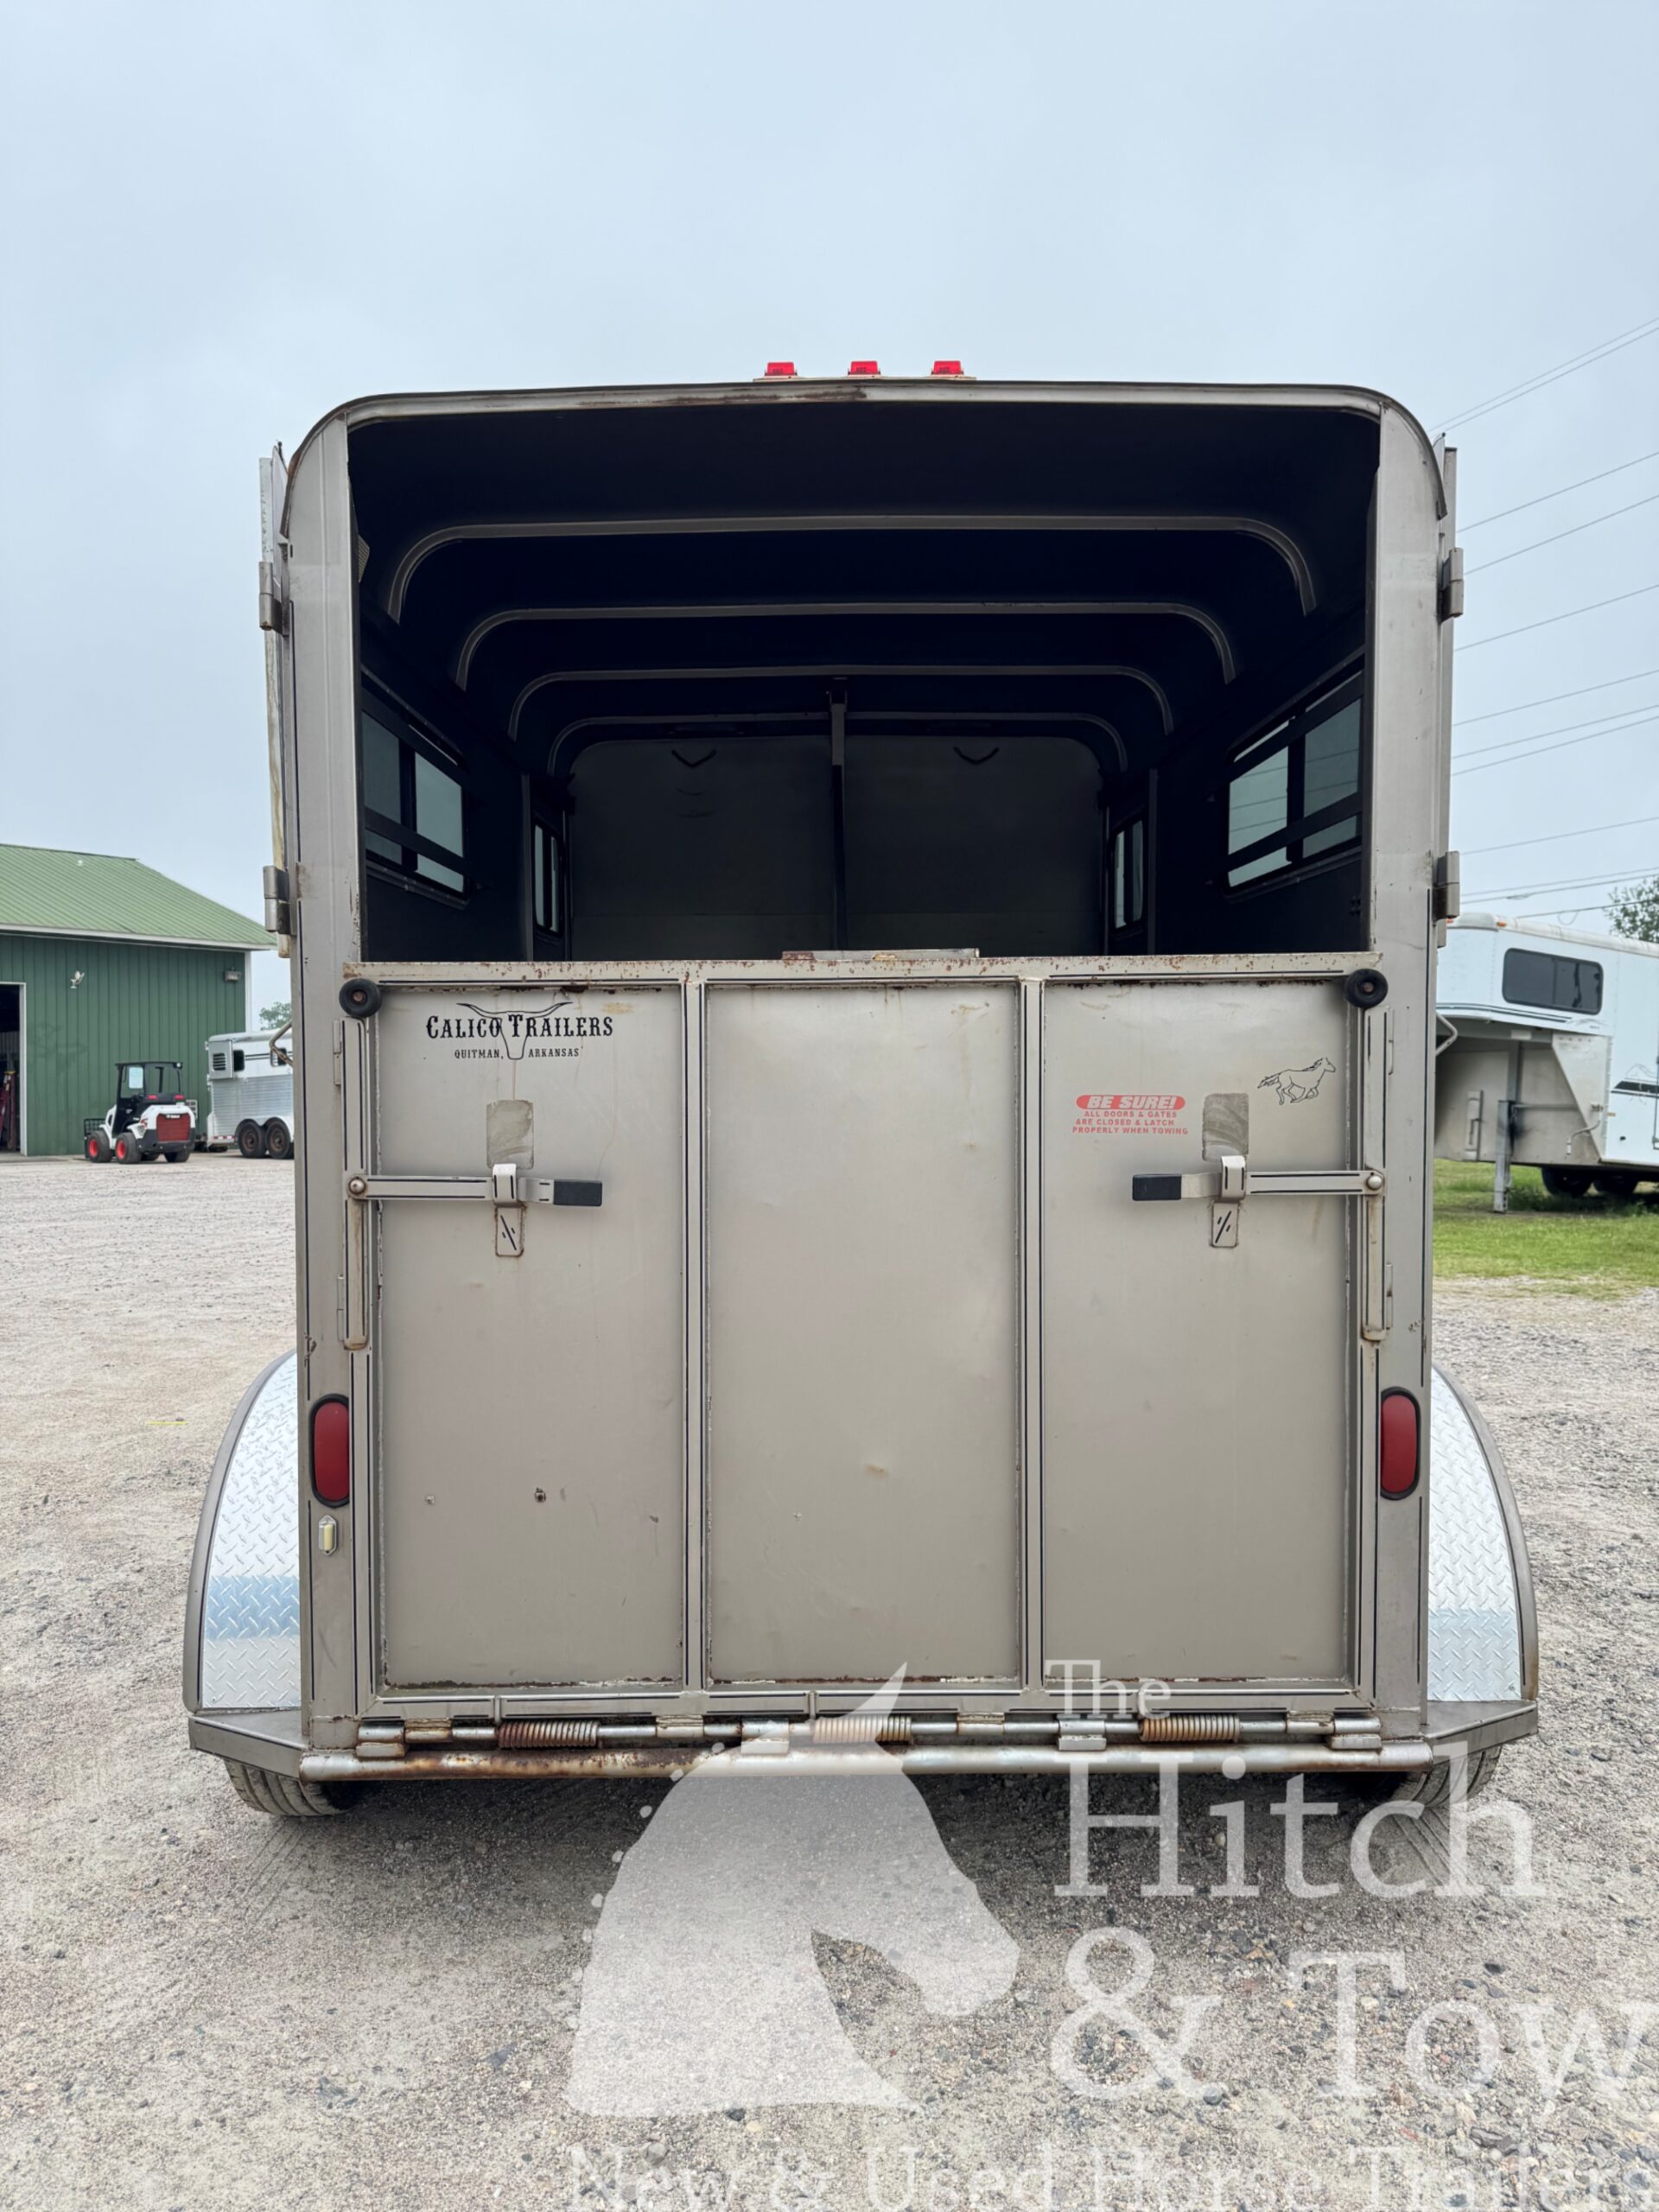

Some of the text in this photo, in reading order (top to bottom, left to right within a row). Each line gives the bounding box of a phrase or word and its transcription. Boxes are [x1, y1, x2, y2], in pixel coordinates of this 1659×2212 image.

[454, 1048, 580, 1060] QUITMAN, ARKANSAS
[1088, 1096, 1177, 1110] BE SURE!
